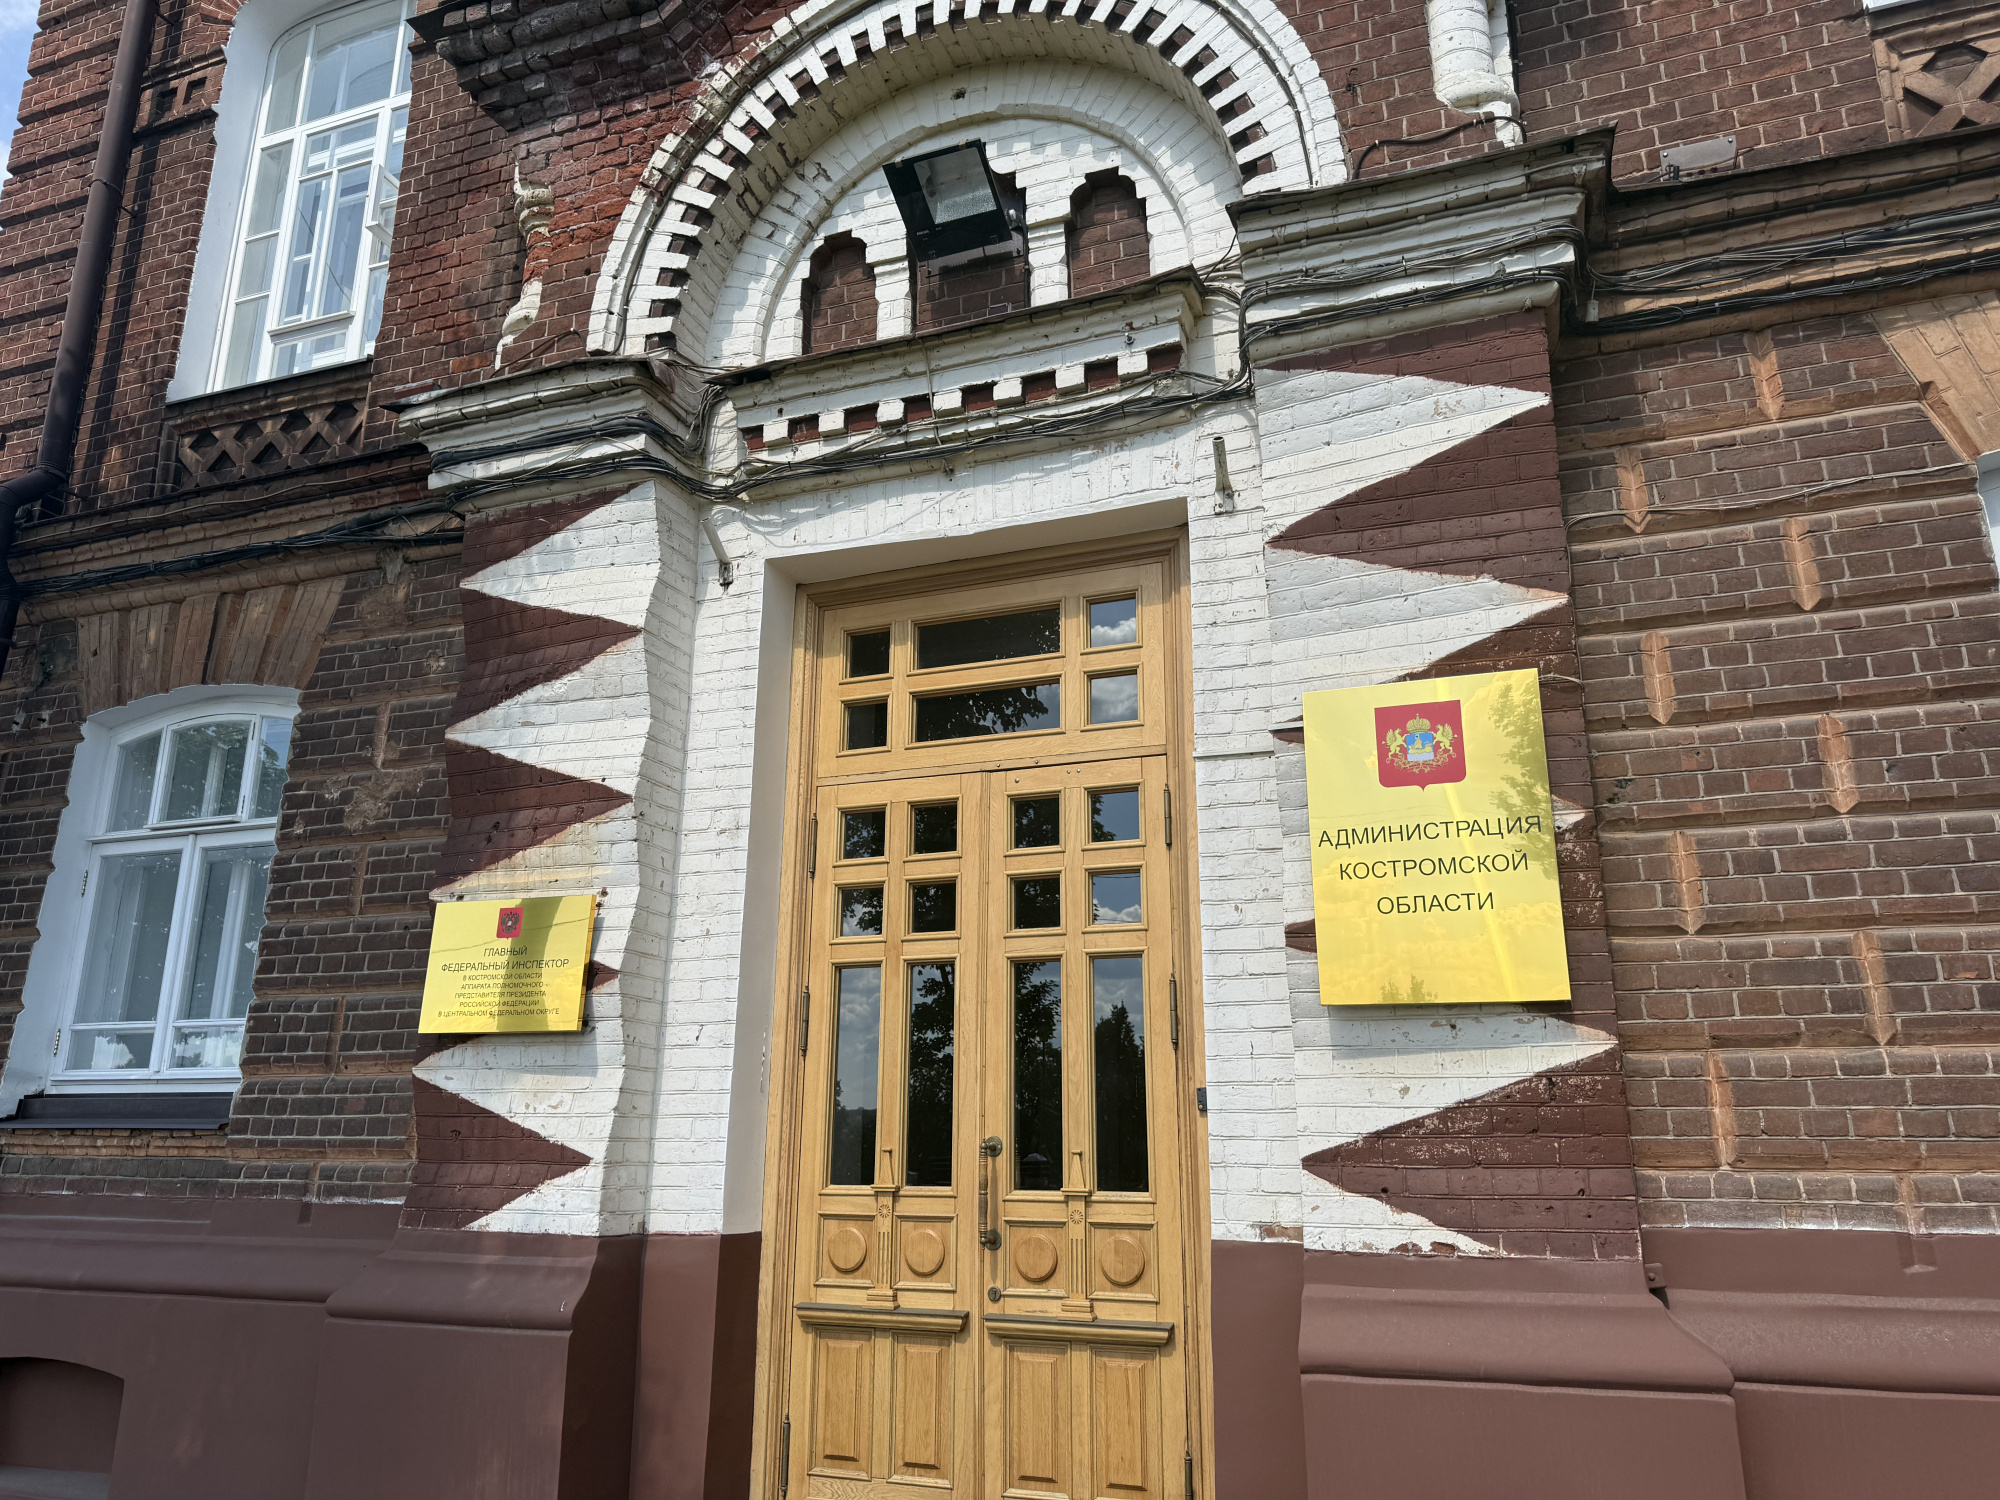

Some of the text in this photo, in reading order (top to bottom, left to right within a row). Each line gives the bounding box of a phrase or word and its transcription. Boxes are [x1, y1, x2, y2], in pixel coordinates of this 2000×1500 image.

[1318, 815, 1542, 849] АДМИНИСТРАЦИЯ
[1339, 849, 1529, 881] КОСТРОМСКОЙ
[1377, 892, 1494, 914] ОБЛАСТИ
[484, 946, 527, 957] ГЛАВНЫЙ
[441, 959, 569, 973] ФЕДЕРАЛЬНЫЙ ИНСПЕКТОР
[468, 972, 513, 980] КОСТРОМСКОЙ
[454, 991, 505, 999] ПРЕДСТАВИТЕЛЯ
[459, 999, 500, 1007] РОССИЙСКОЙ
